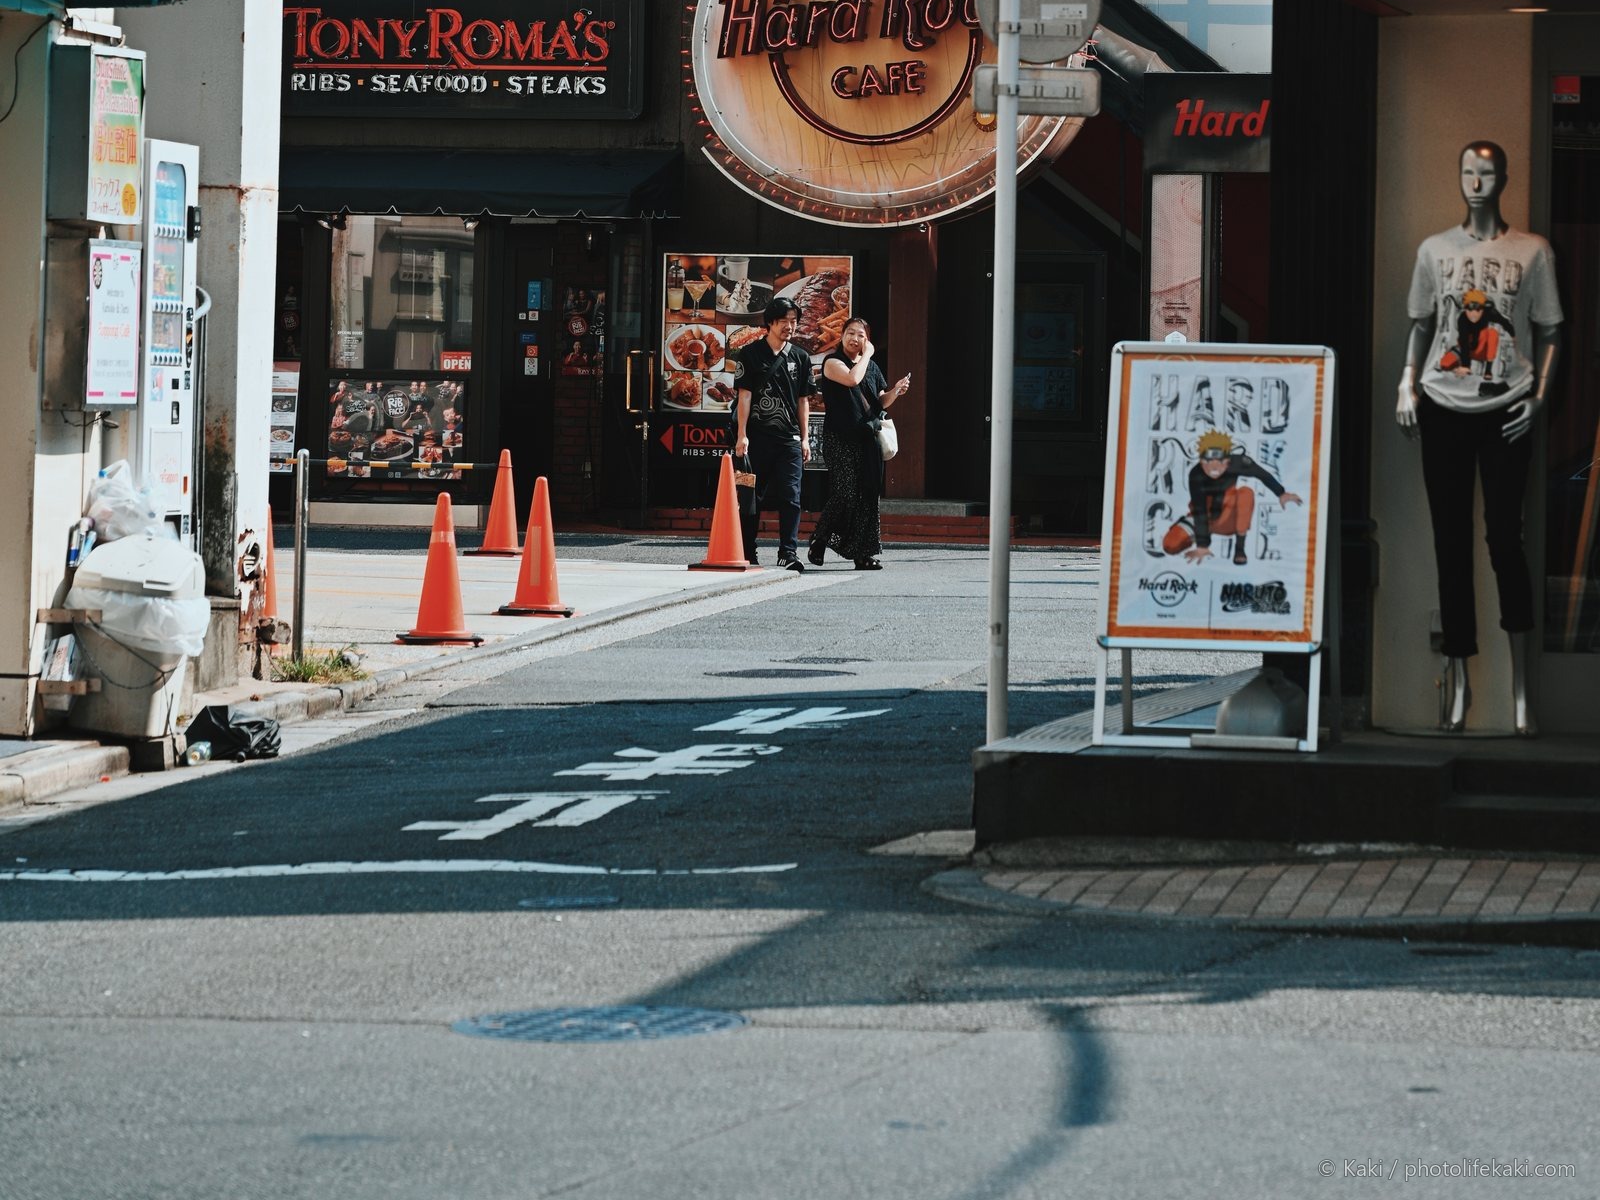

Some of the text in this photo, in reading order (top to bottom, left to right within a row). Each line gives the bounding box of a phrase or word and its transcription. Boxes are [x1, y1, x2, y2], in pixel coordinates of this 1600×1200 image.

[284, 7, 426, 60] TONY
[291, 73, 607, 96] RIBS SEAFOOD STEAKS
[831, 60, 927, 99] CAFE
[1173, 99, 1271, 136] Hard
[443, 359, 471, 369] OPEN
[1149, 374, 1290, 434] HARD
[1142, 499, 1282, 560] CE
[1138, 578, 1198, 594] Hard Rock
[1220, 581, 1287, 604] NARUTO
